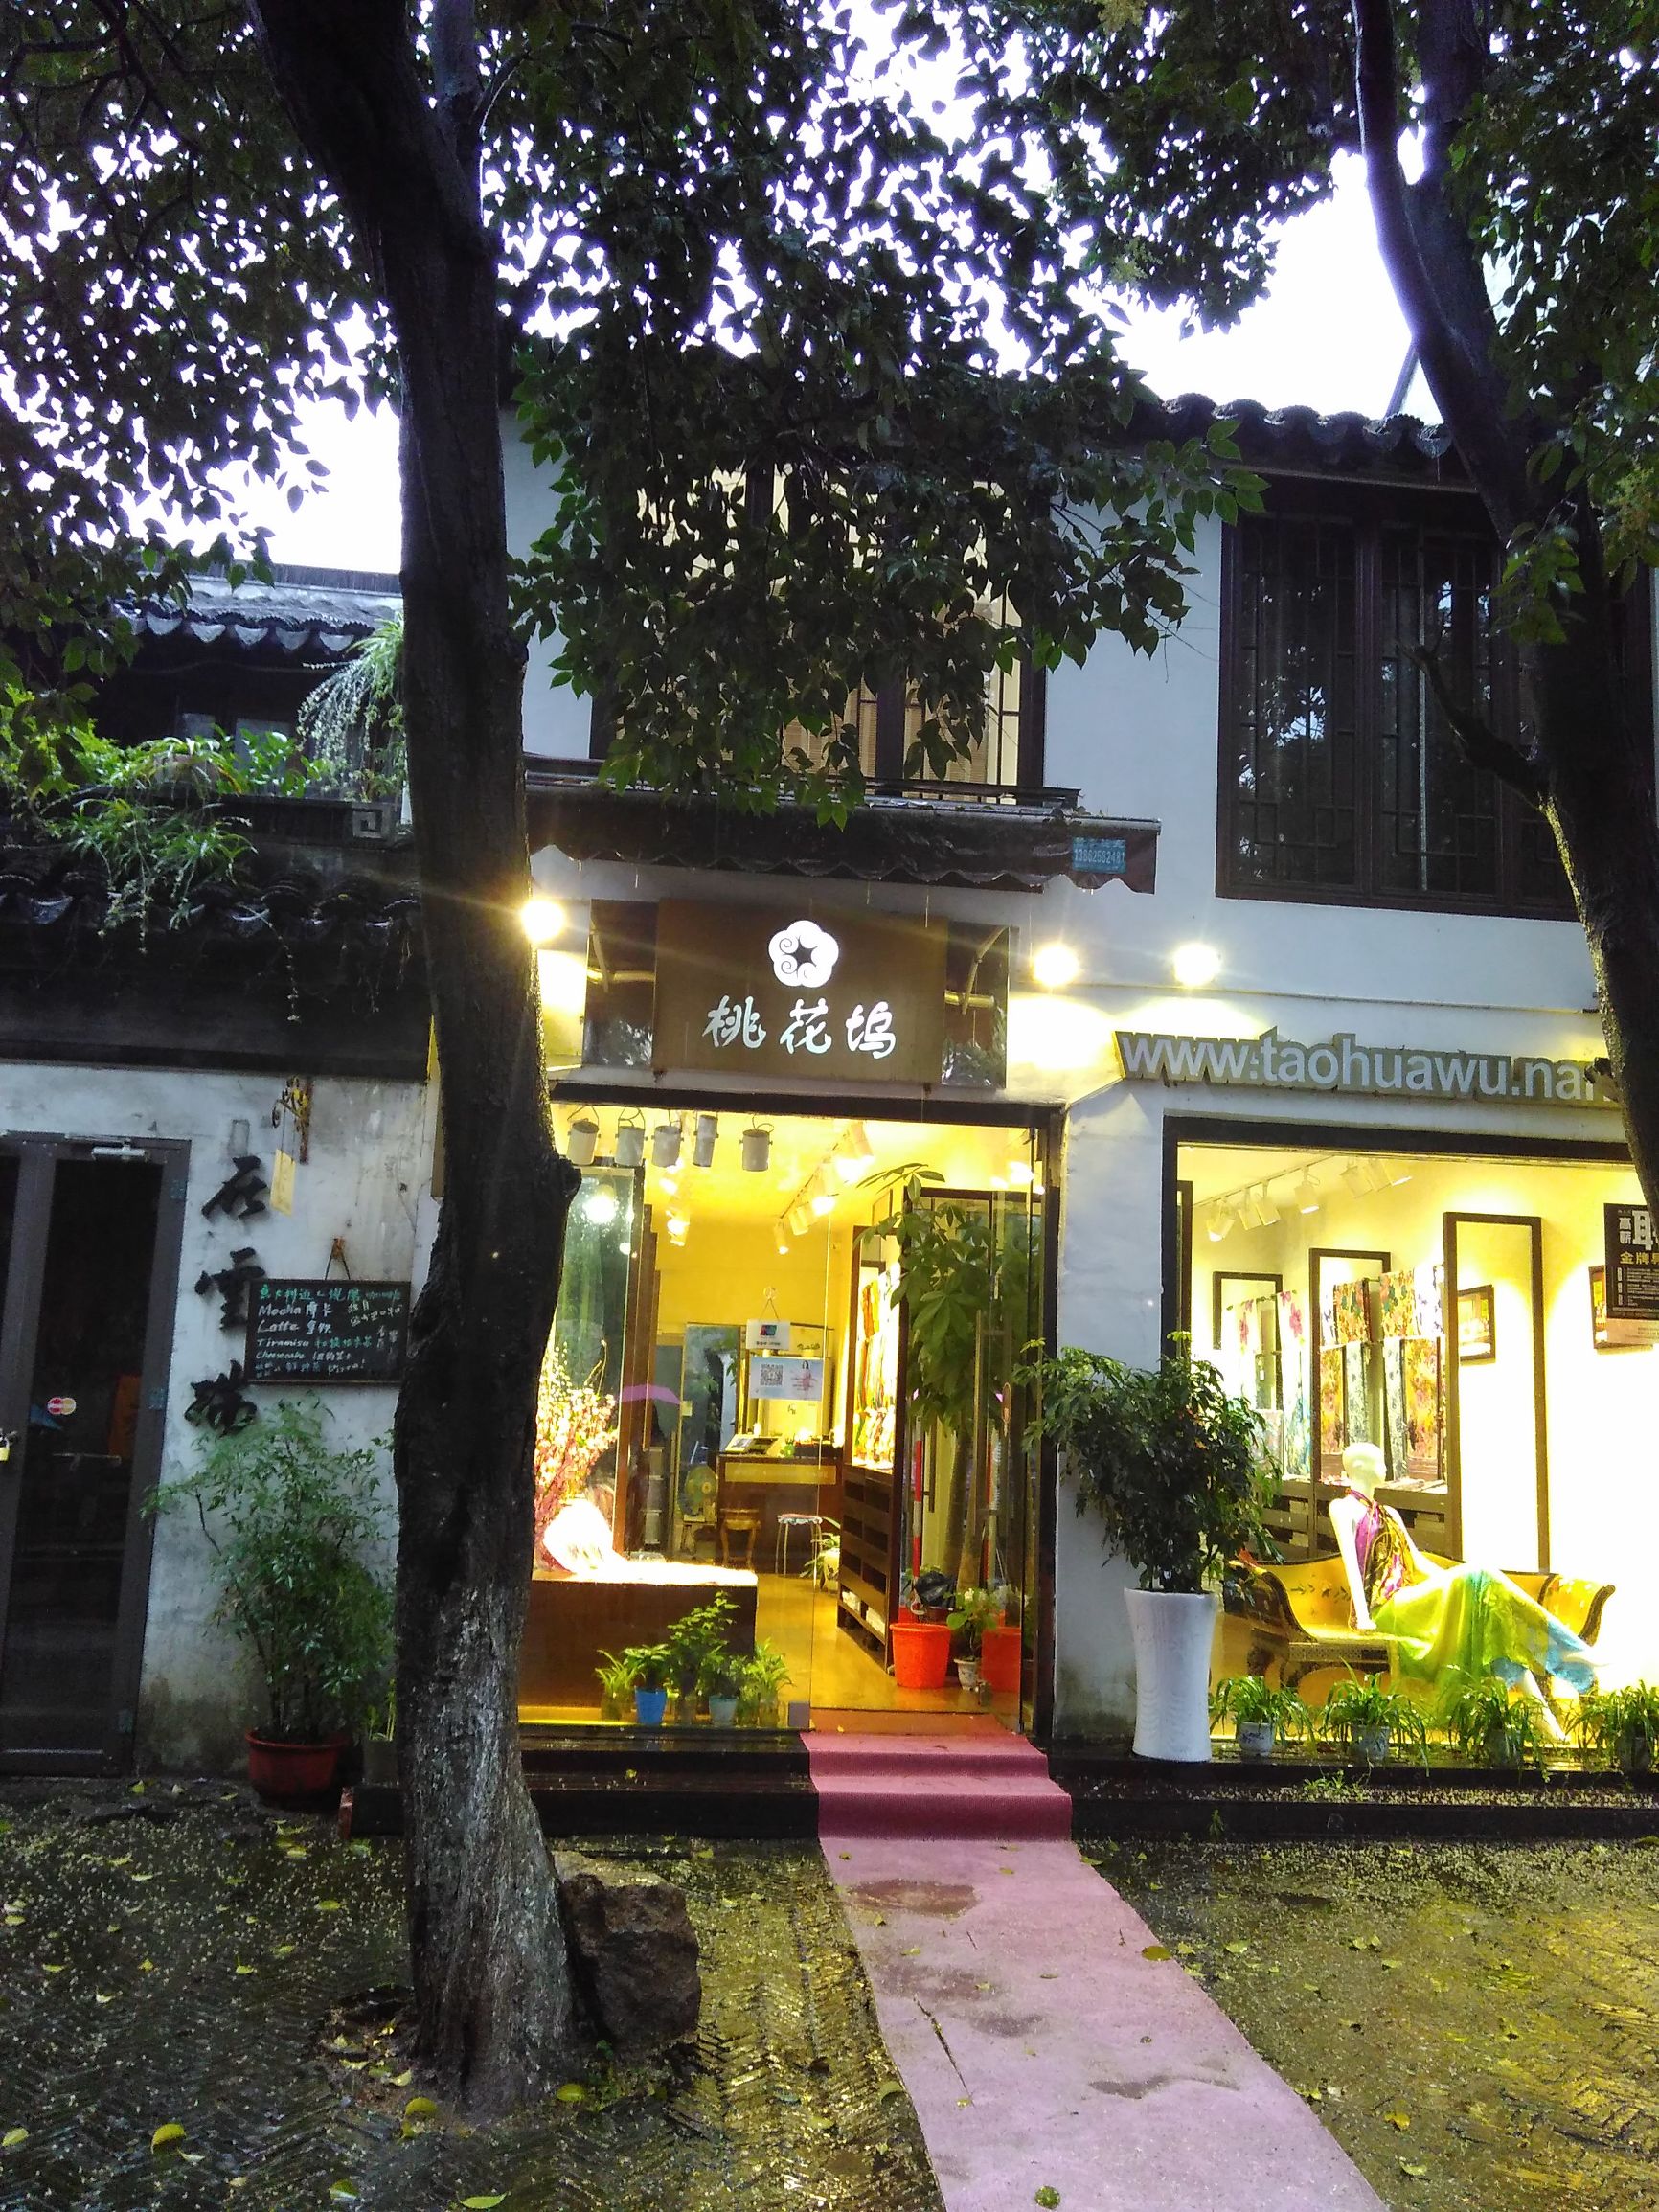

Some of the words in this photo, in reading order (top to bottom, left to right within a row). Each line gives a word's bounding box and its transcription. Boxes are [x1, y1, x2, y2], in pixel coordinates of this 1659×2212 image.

[702, 994, 897, 1059] 桃花坞
[258, 1299, 302, 1317] Mocha
[257, 1319, 300, 1334] Latte
[257, 1336, 309, 1348] Tiramisu
